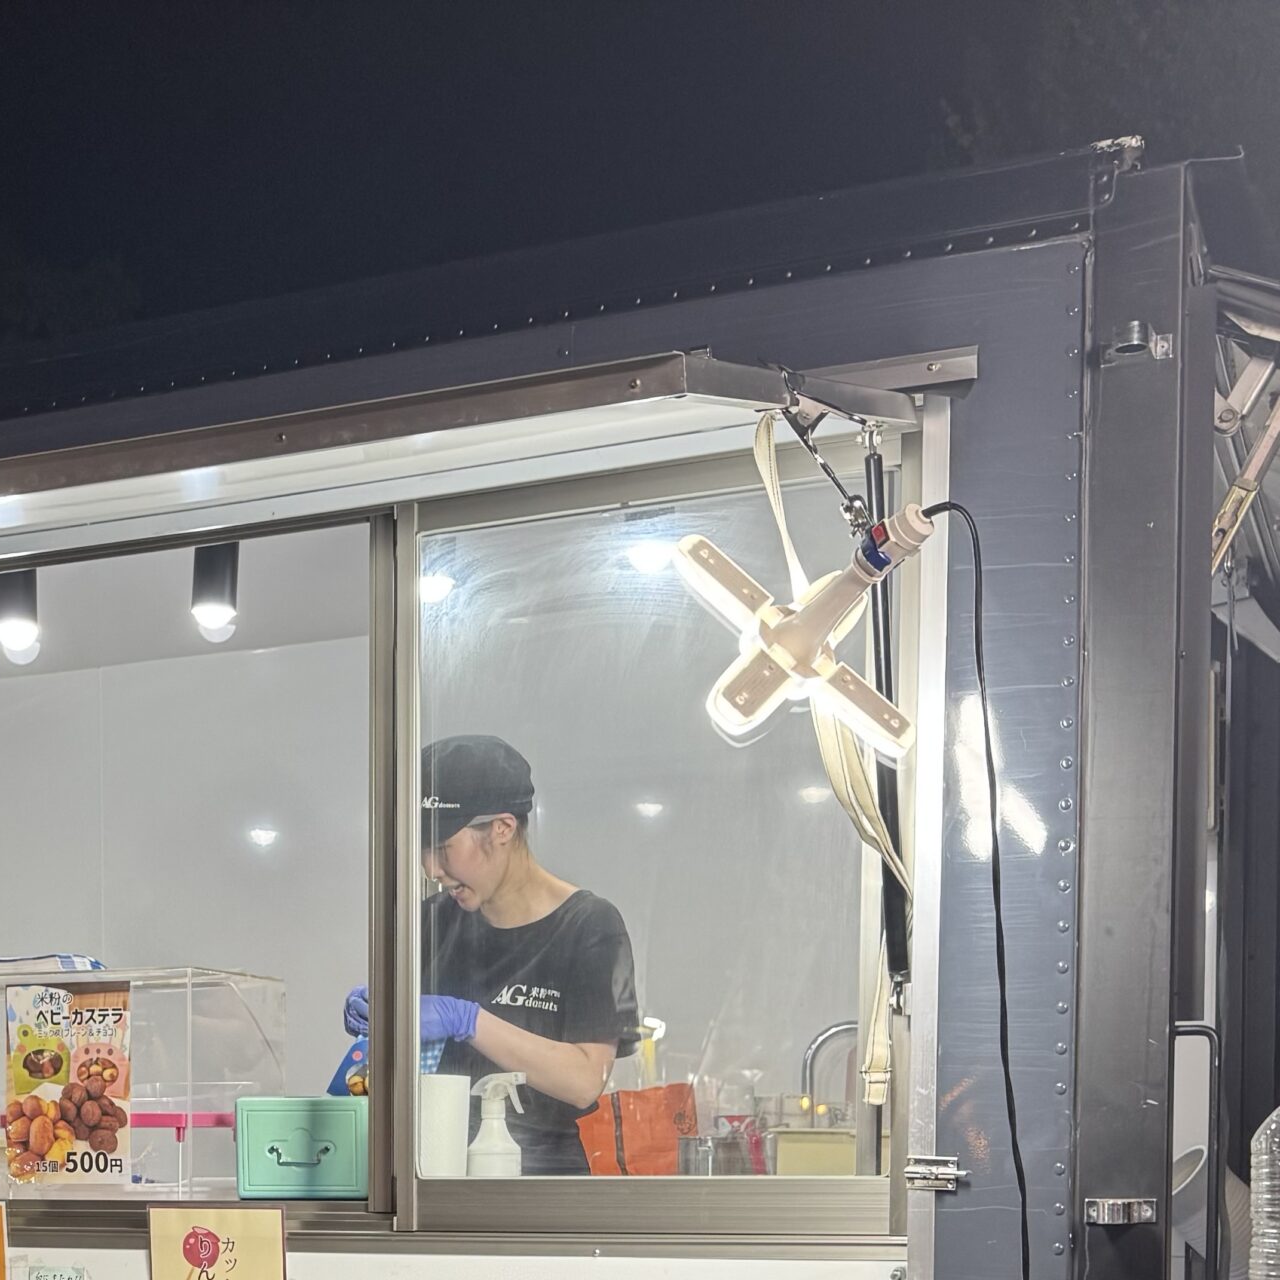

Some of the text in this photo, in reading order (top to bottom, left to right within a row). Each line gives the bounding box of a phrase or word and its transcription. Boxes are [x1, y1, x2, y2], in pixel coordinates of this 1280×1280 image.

[36, 991, 72, 1006] 米粉の
[36, 1007, 123, 1026] ベビーカステラ
[35, 1151, 123, 1174] 15個 500円
